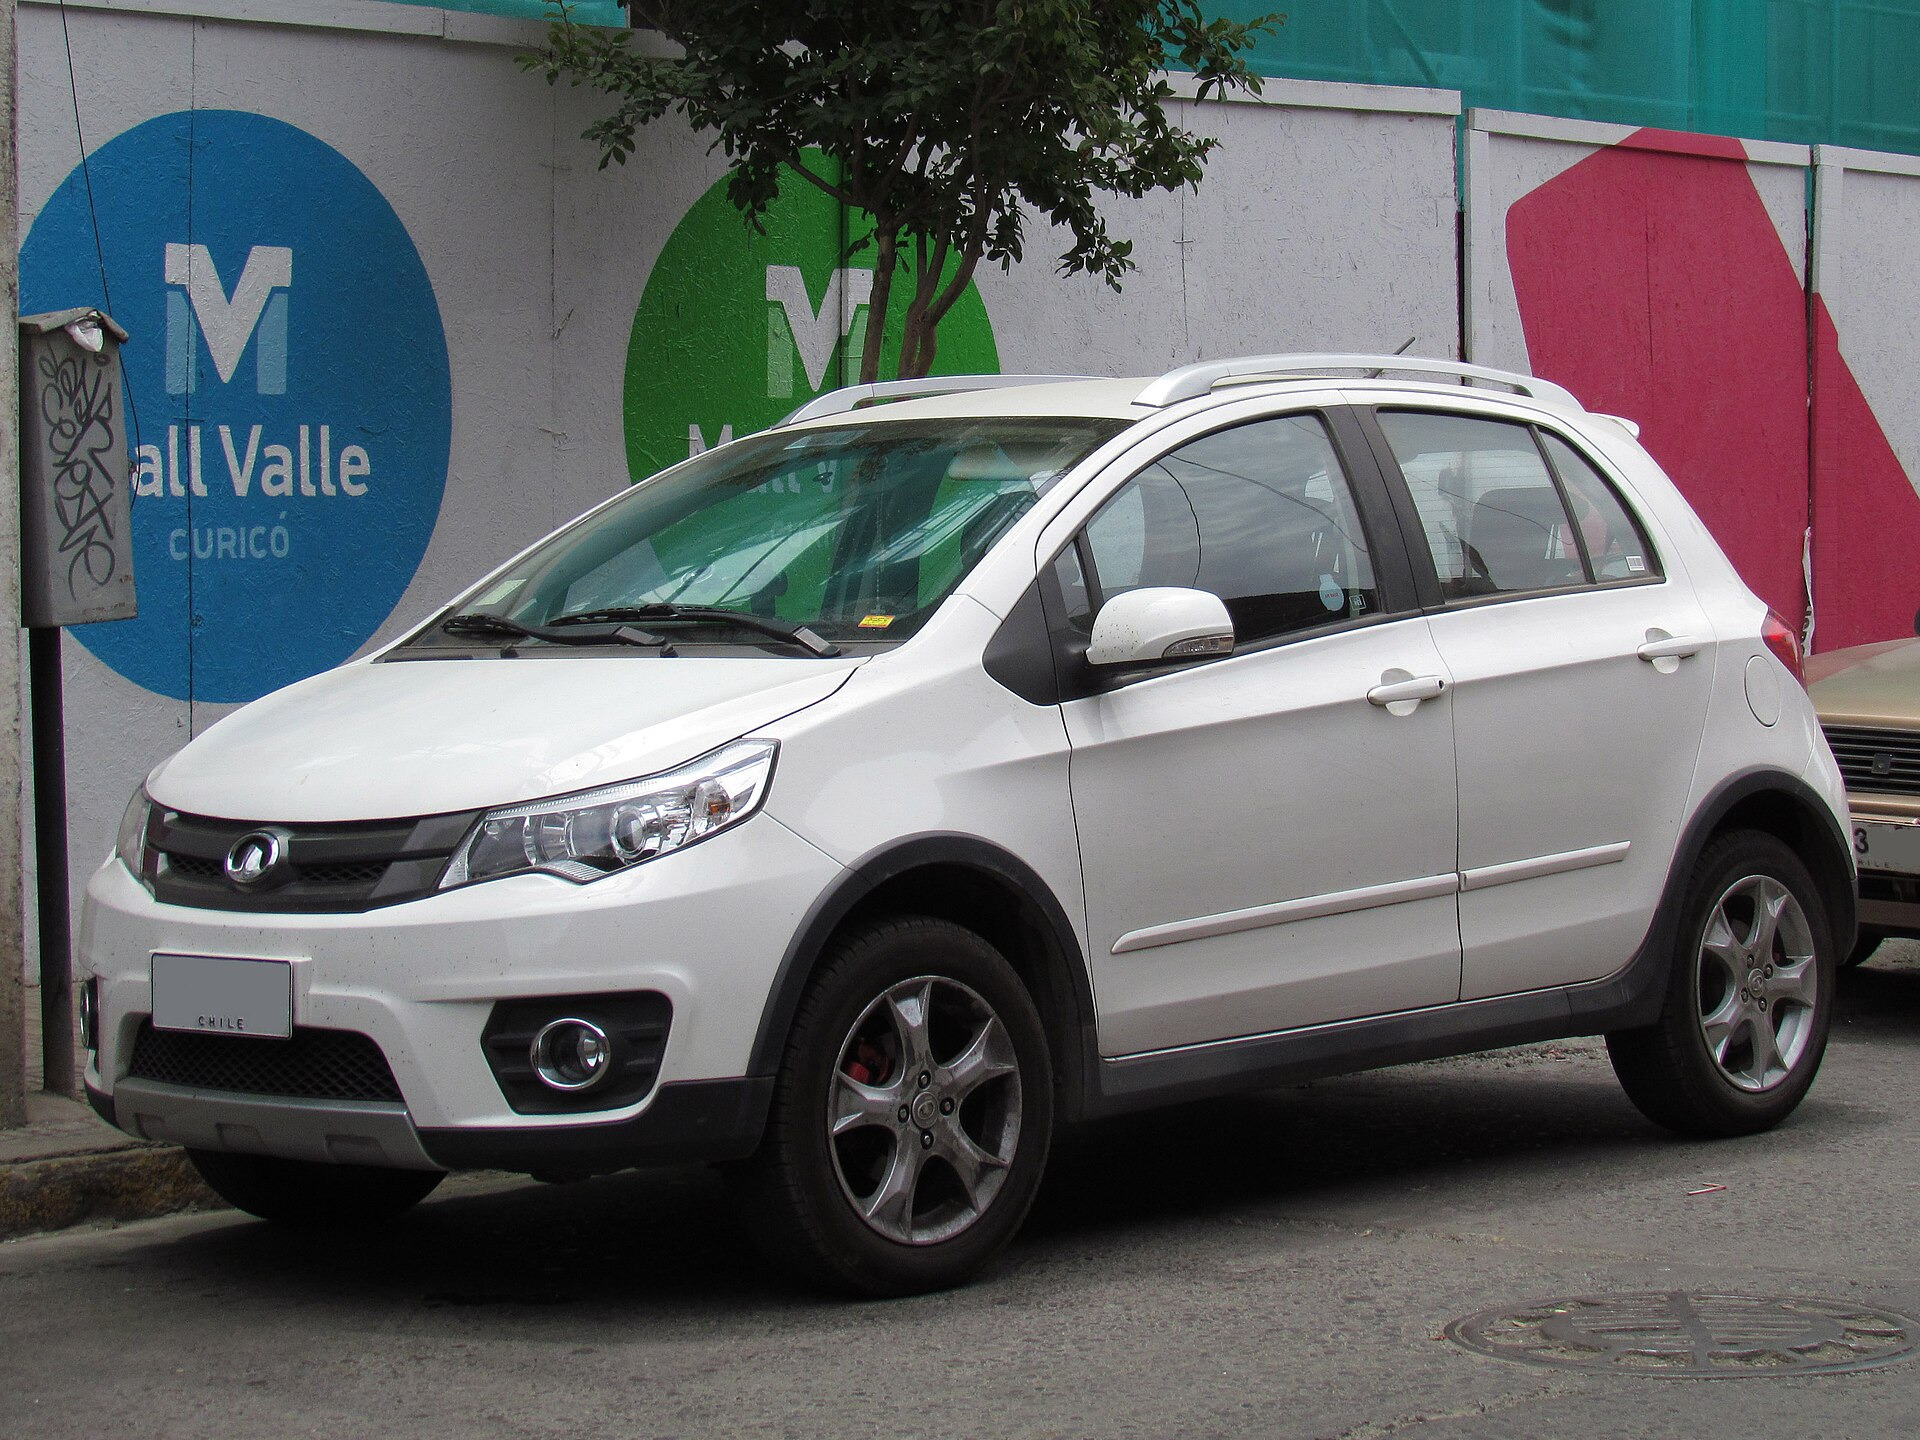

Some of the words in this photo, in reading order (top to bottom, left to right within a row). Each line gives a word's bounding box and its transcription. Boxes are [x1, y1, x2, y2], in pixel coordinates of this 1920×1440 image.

[131, 424, 208, 497] all
[218, 424, 371, 497] Valle
[169, 510, 290, 561] CURICÓ
[198, 1015, 245, 1030] CHILE
